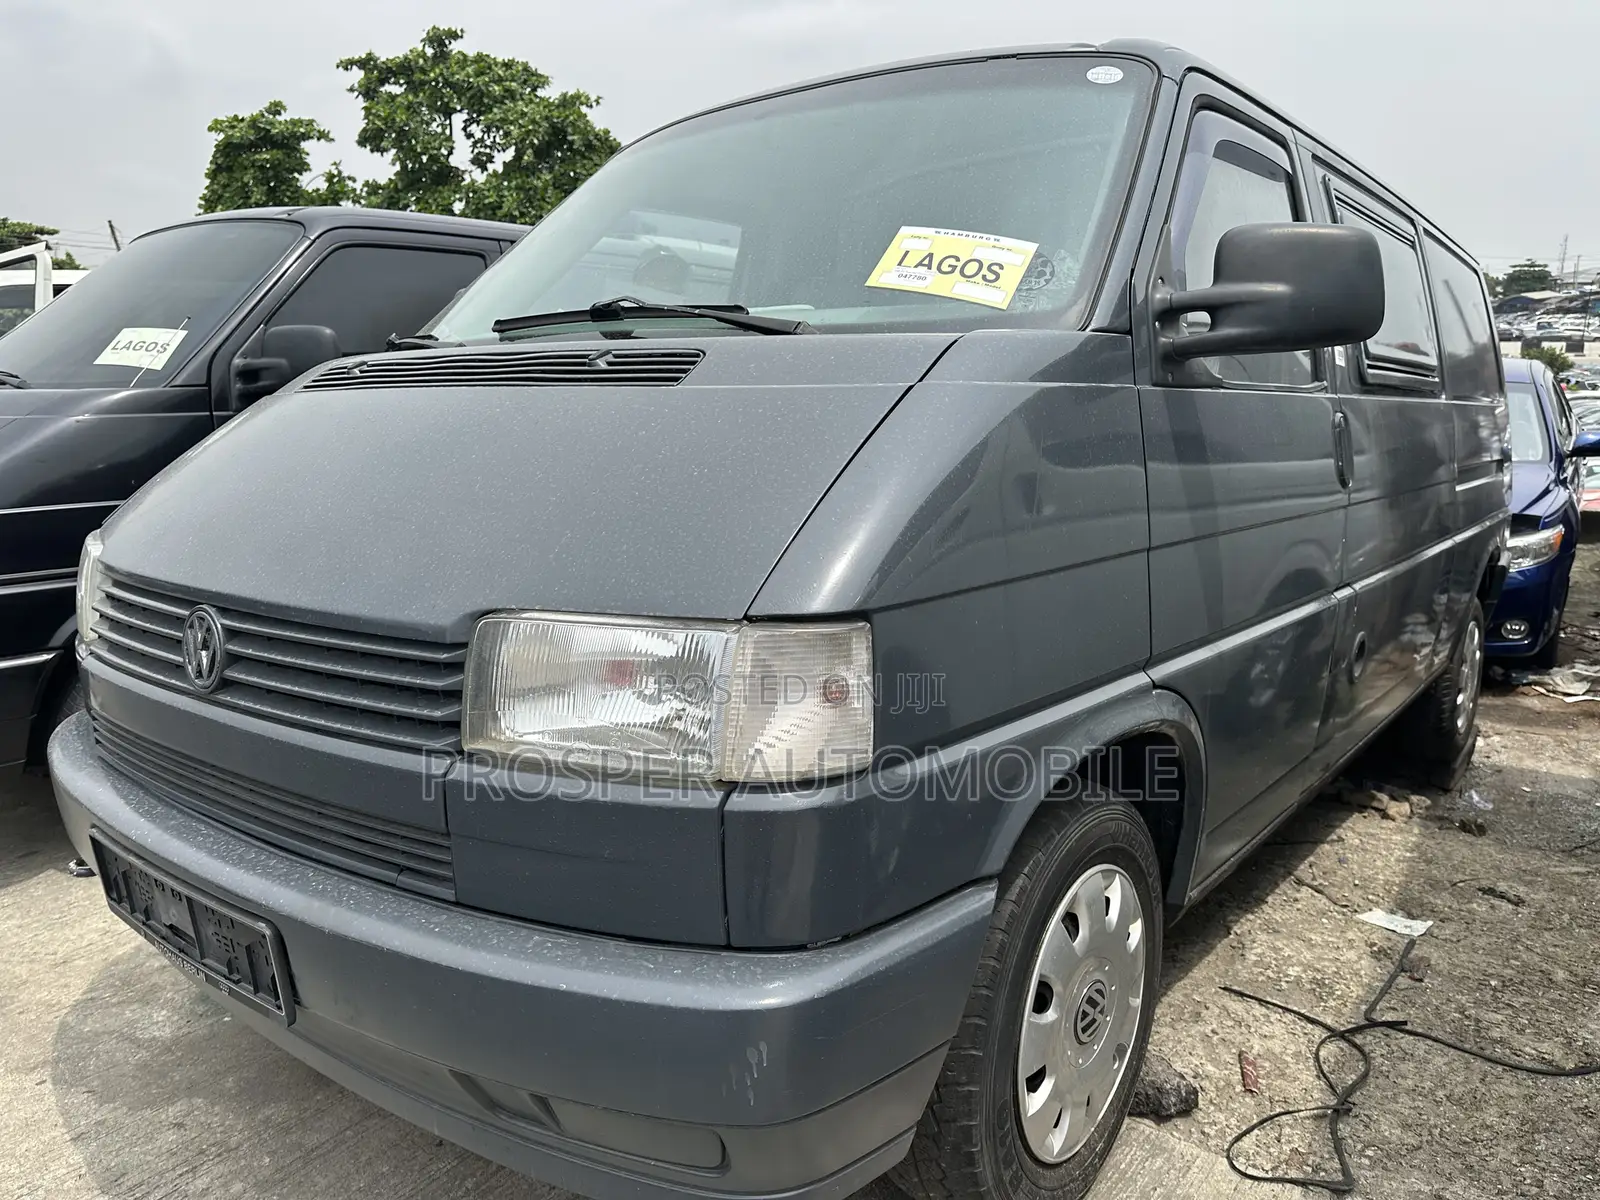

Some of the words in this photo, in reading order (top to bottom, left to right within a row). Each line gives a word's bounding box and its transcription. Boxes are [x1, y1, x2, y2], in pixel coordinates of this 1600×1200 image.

[943, 231, 991, 241] HAMBURG
[896, 250, 1004, 283] LAGOS
[111, 340, 170, 354] LAGOS
